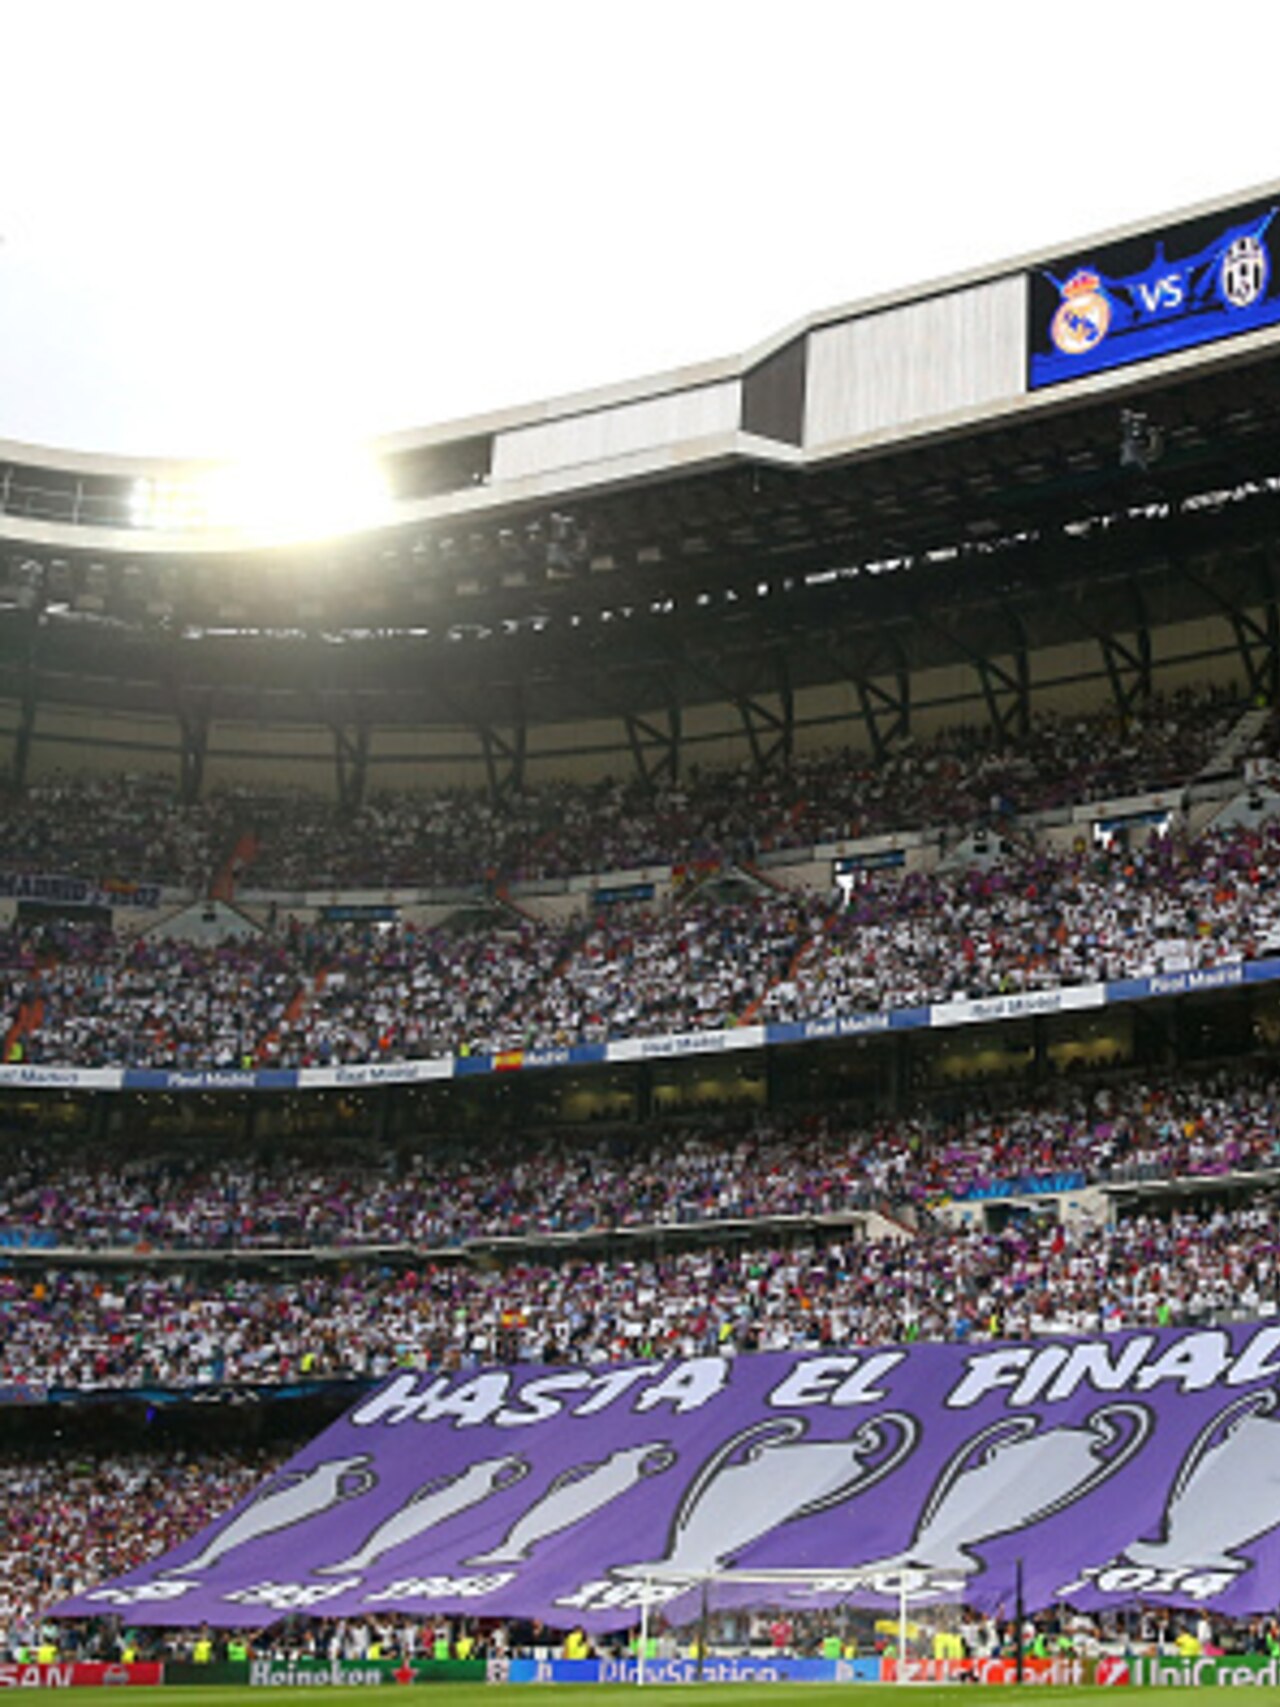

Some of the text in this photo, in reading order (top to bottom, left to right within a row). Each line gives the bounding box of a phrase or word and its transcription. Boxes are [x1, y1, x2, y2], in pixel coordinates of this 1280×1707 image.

[1139, 274, 1183, 312] VS
[350, 1354, 732, 1428] HASTA
[768, 1350, 907, 1407] EL
[250, 1661, 383, 1686] Heineken
[598, 1659, 780, 1682] PlayStation
